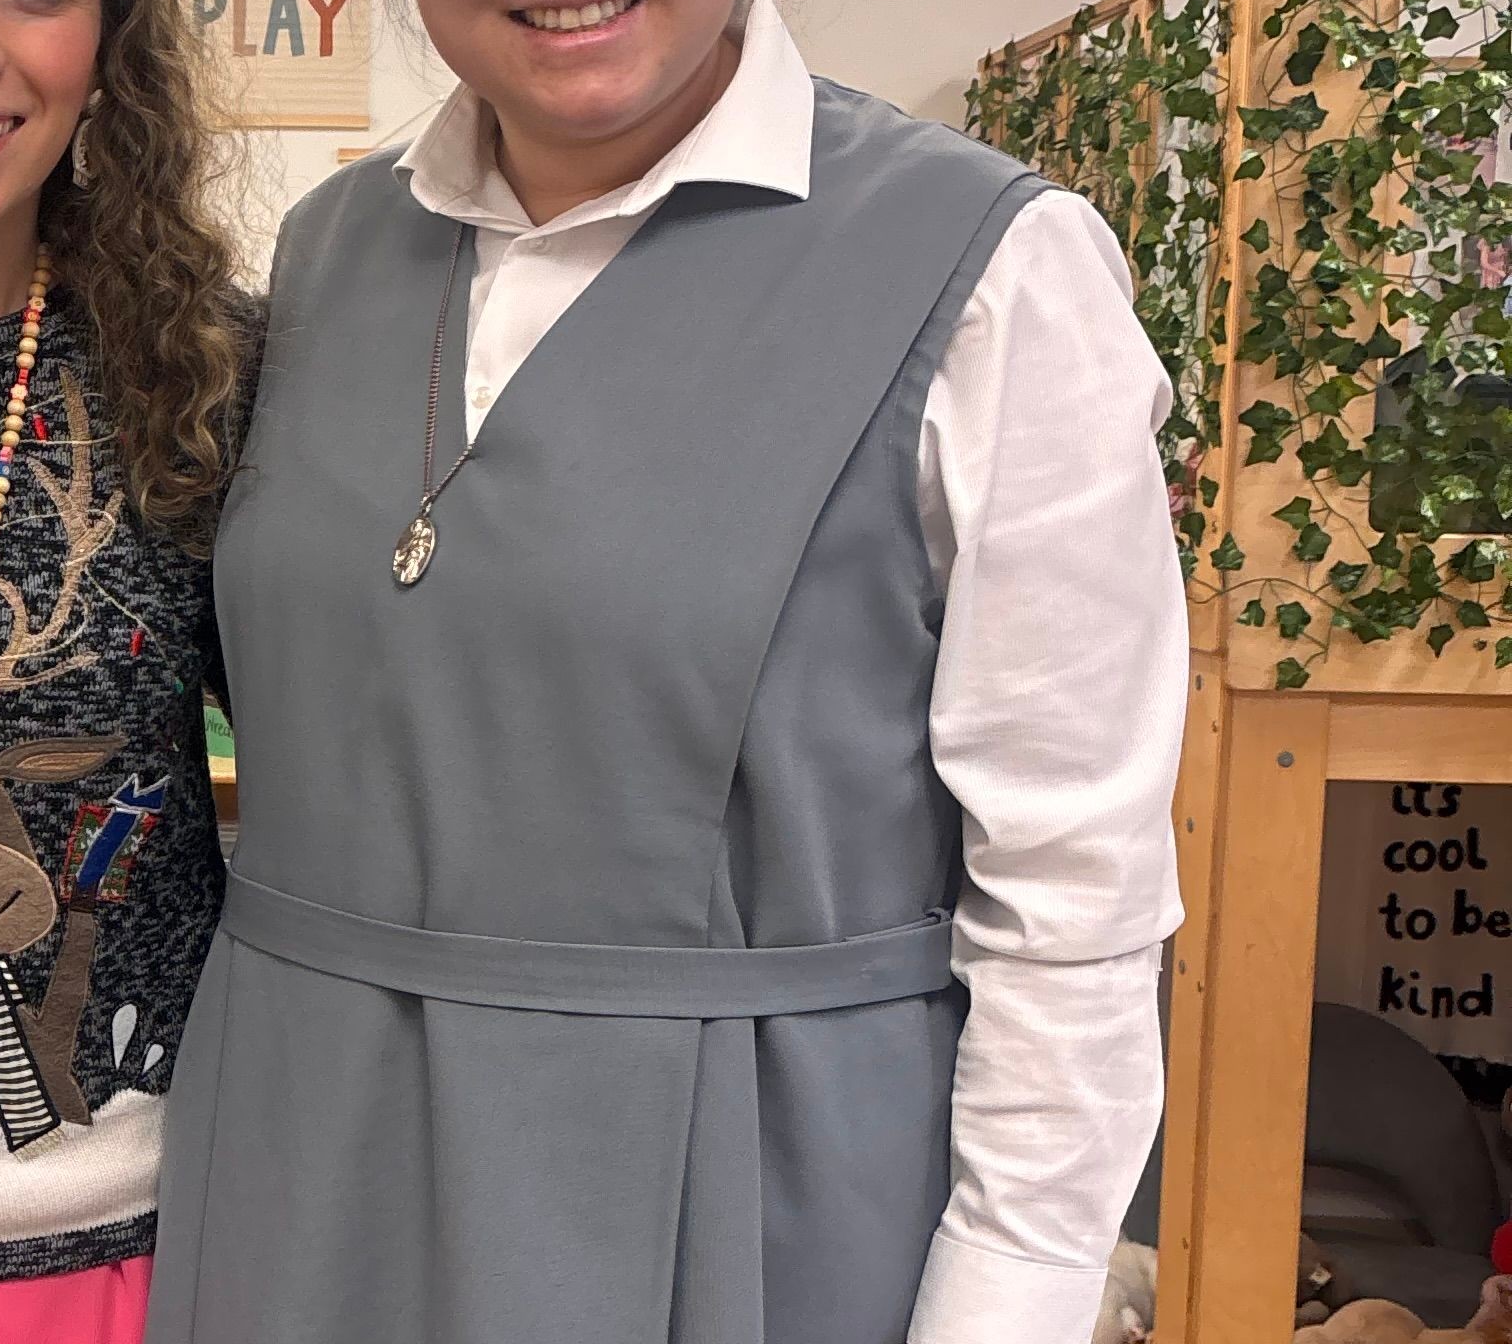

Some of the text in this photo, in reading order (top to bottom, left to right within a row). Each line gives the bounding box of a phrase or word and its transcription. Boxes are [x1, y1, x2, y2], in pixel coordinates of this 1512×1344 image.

[1383, 826, 1487, 873] cool
[1378, 888, 1512, 941] to be
[1378, 965, 1493, 1019] kind
